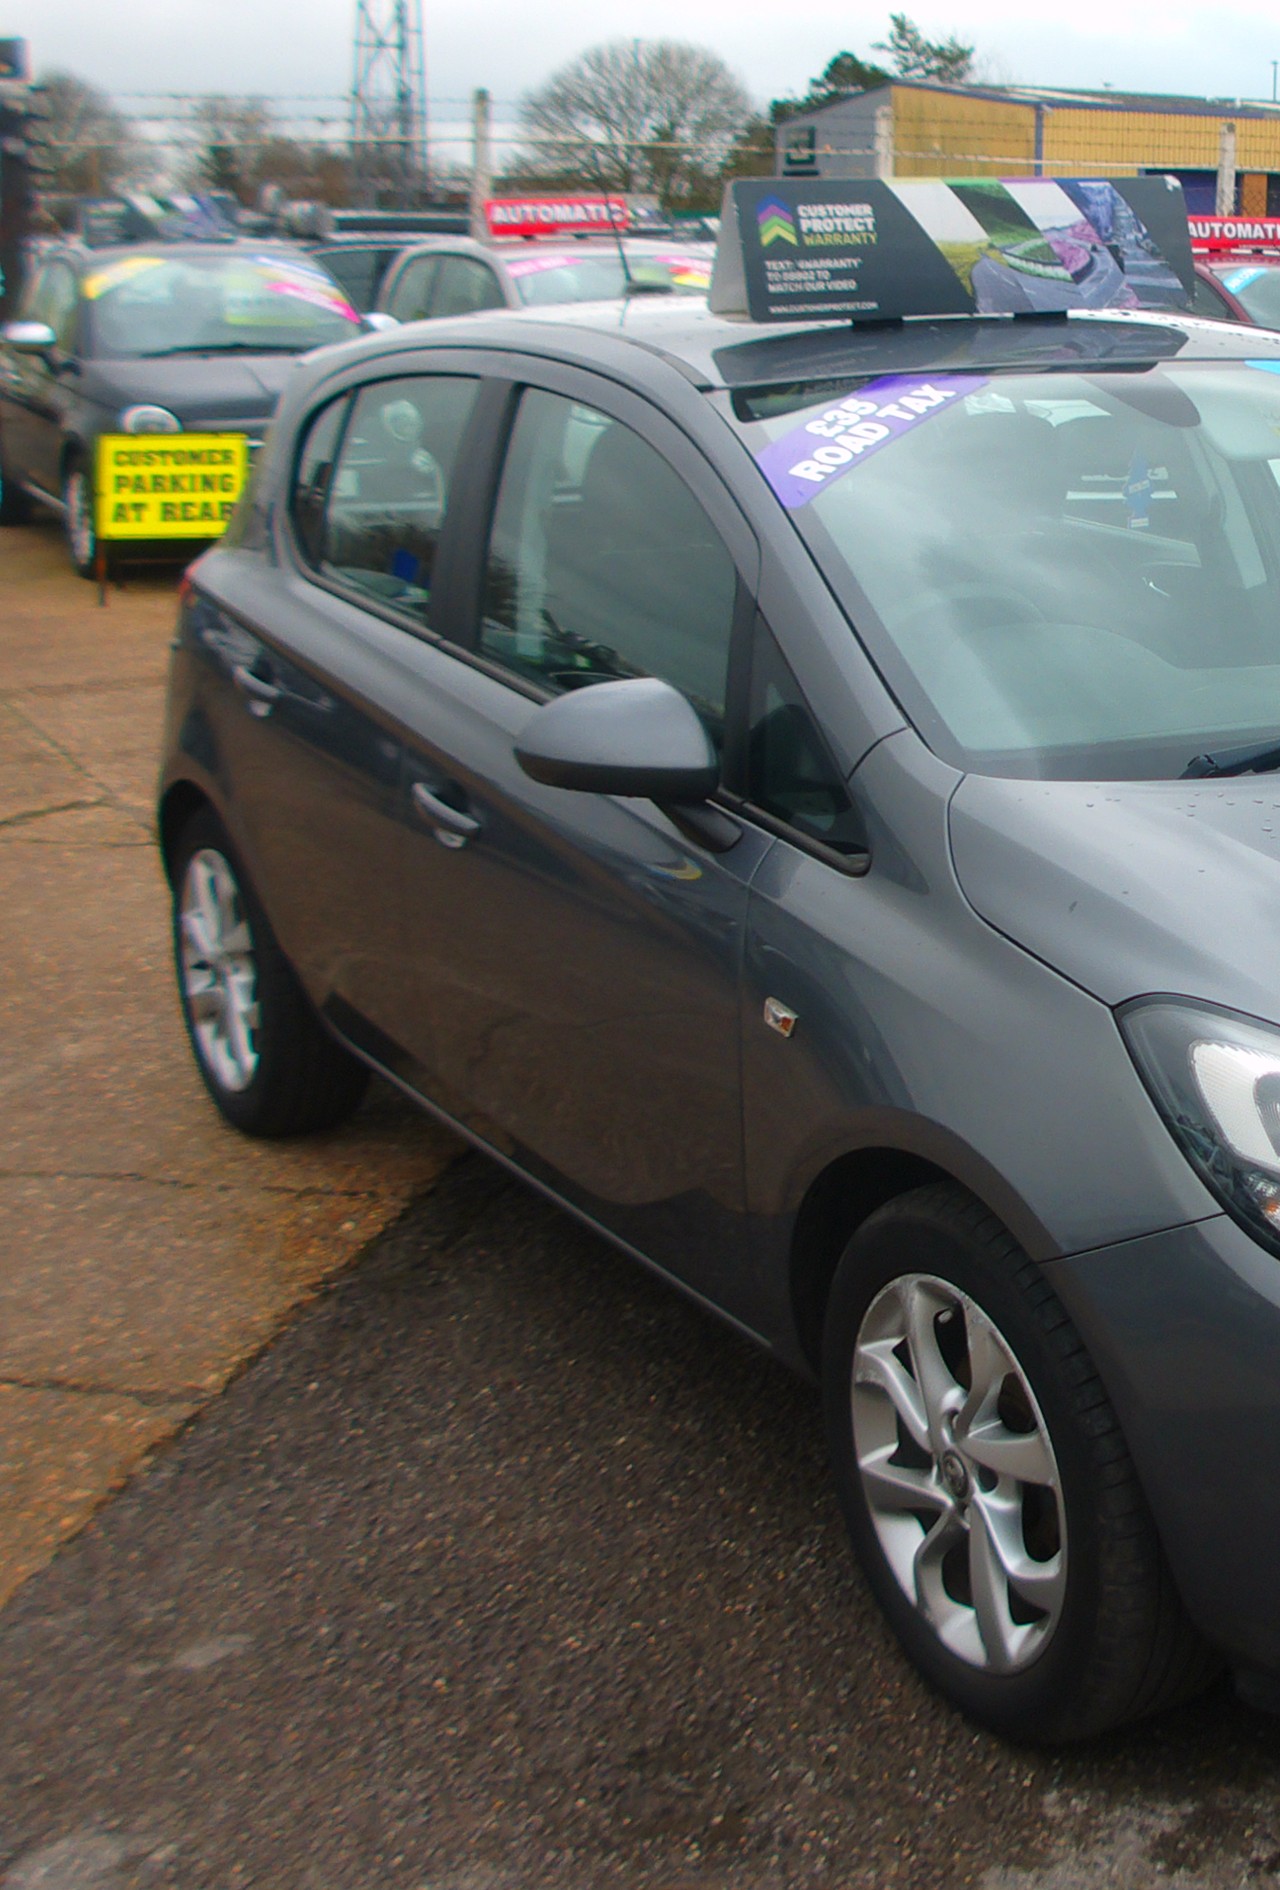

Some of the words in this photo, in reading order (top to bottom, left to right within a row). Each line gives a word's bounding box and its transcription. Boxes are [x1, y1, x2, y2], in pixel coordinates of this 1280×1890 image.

[492, 203, 625, 223] AUTOMATIC
[797, 203, 873, 218] CUSTOMER
[799, 217, 877, 233] PROTECT
[803, 232, 878, 246] WARRANTY
[804, 398, 879, 439] £35
[787, 421, 891, 483] ROAD
[875, 383, 957, 422] TAX
[113, 450, 236, 467] CUSTOMER
[114, 474, 235, 495] PARKING
[112, 502, 148, 523] AT
